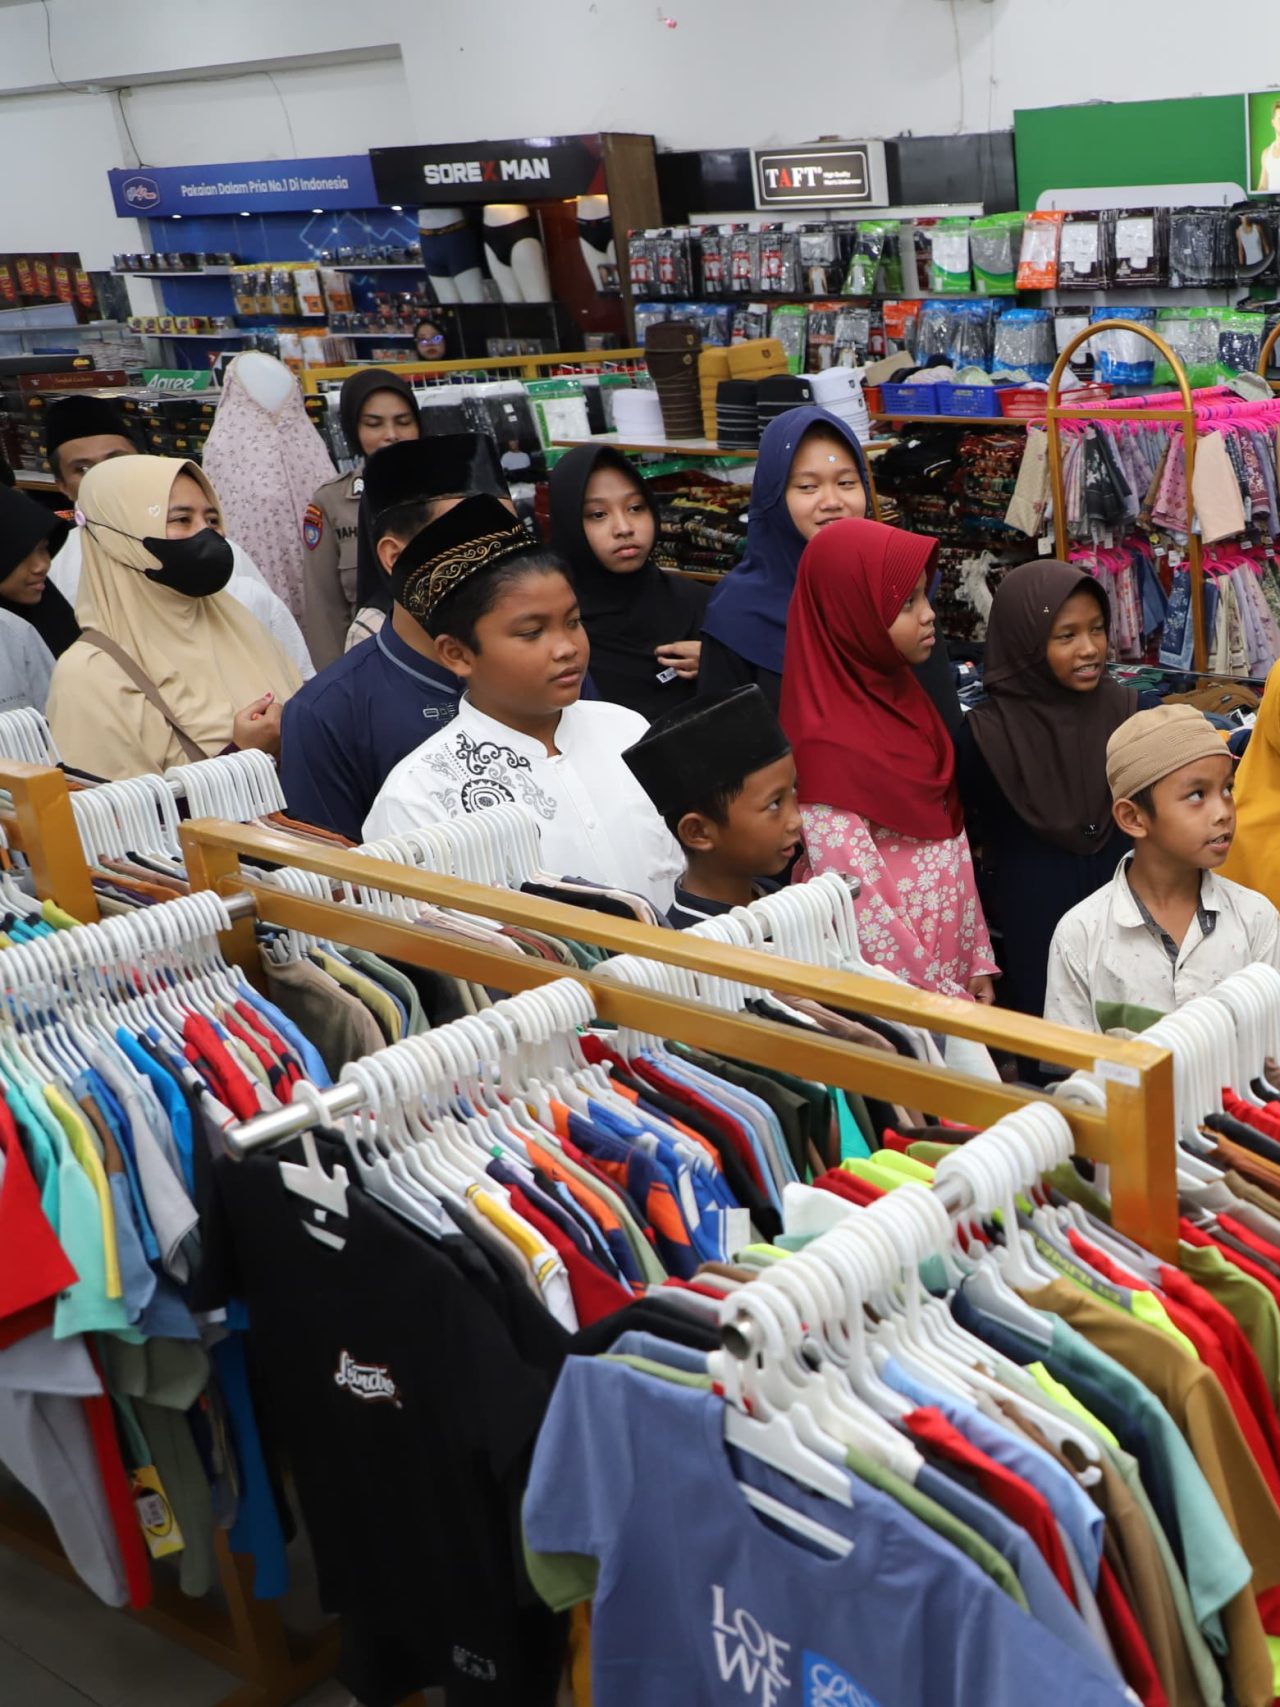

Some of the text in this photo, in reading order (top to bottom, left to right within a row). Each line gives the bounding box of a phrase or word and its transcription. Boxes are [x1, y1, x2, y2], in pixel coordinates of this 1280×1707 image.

[423, 157, 551, 185] SOREX MAN
[764, 166, 817, 189] TAFT
[180, 181, 218, 198] Pakaian
[218, 181, 249, 195] Dalam
[249, 179, 268, 193] Pria
[289, 176, 300, 191] Di
[300, 175, 349, 191] Indonesia
[711, 1584, 791, 1688] LOE
